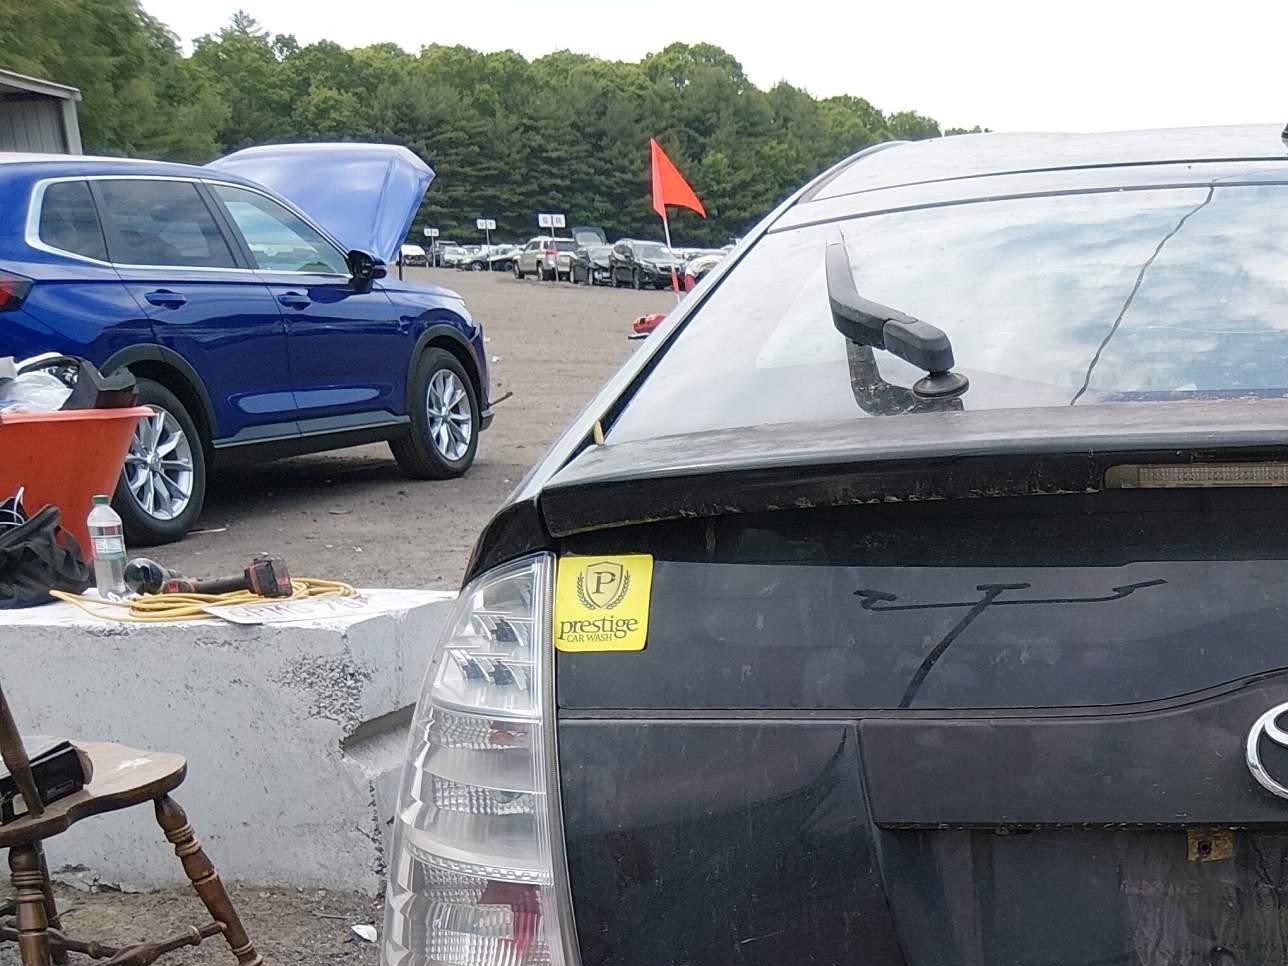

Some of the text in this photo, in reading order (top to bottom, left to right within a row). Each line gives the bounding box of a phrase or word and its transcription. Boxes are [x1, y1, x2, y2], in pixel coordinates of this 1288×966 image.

[592, 571, 616, 594] P
[557, 615, 639, 641] prestige
[567, 633, 613, 643] CAR WASH
